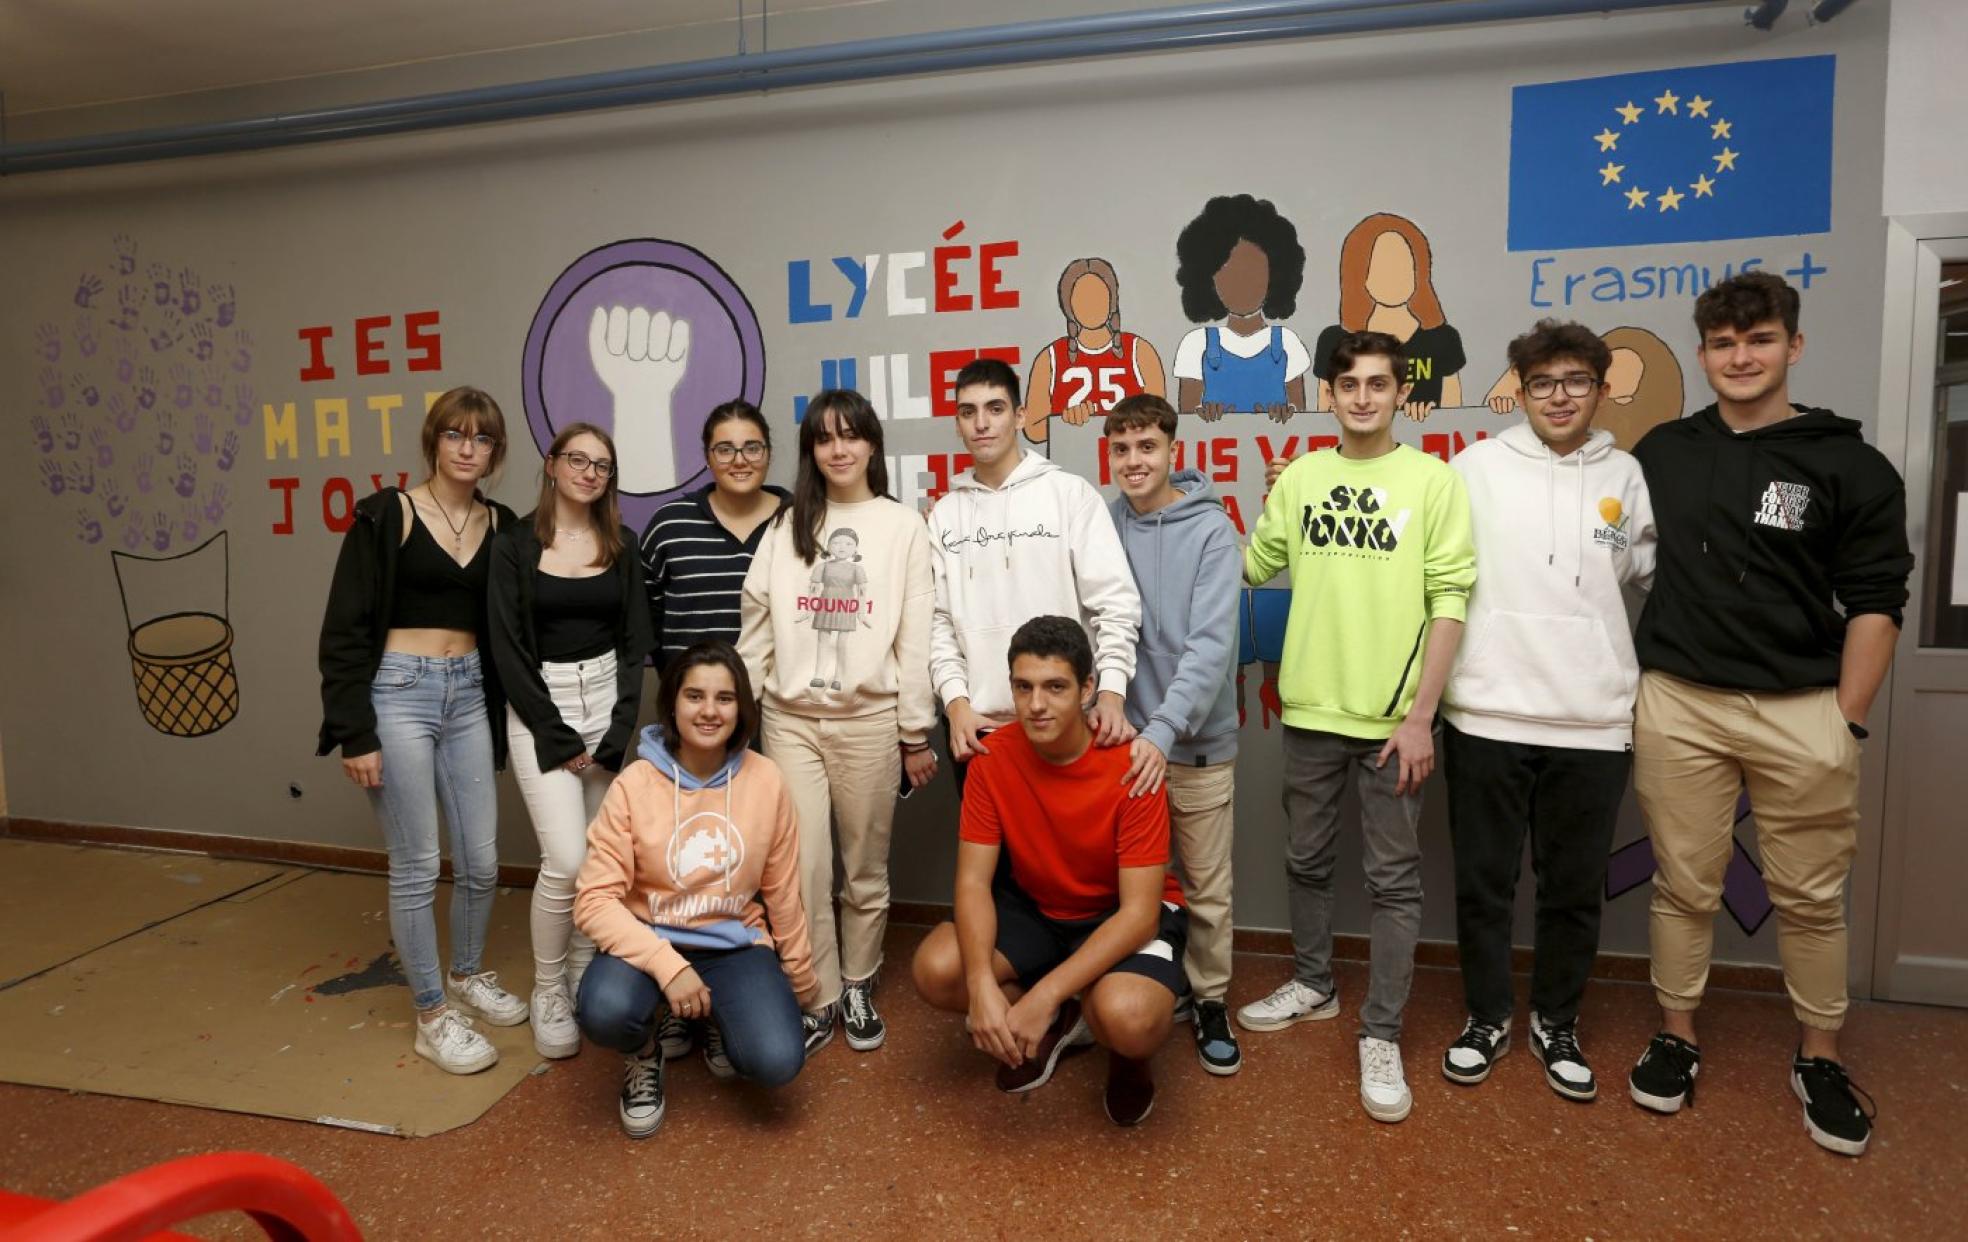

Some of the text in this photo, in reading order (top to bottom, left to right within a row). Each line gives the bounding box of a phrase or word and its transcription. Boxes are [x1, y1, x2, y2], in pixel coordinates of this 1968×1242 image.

[787, 220, 1020, 324] LYCÉE
[298, 310, 442, 382] IES
[1061, 366, 1127, 412] 25
[262, 391, 446, 460] MAT
[796, 596, 874, 615] ROUND 1
